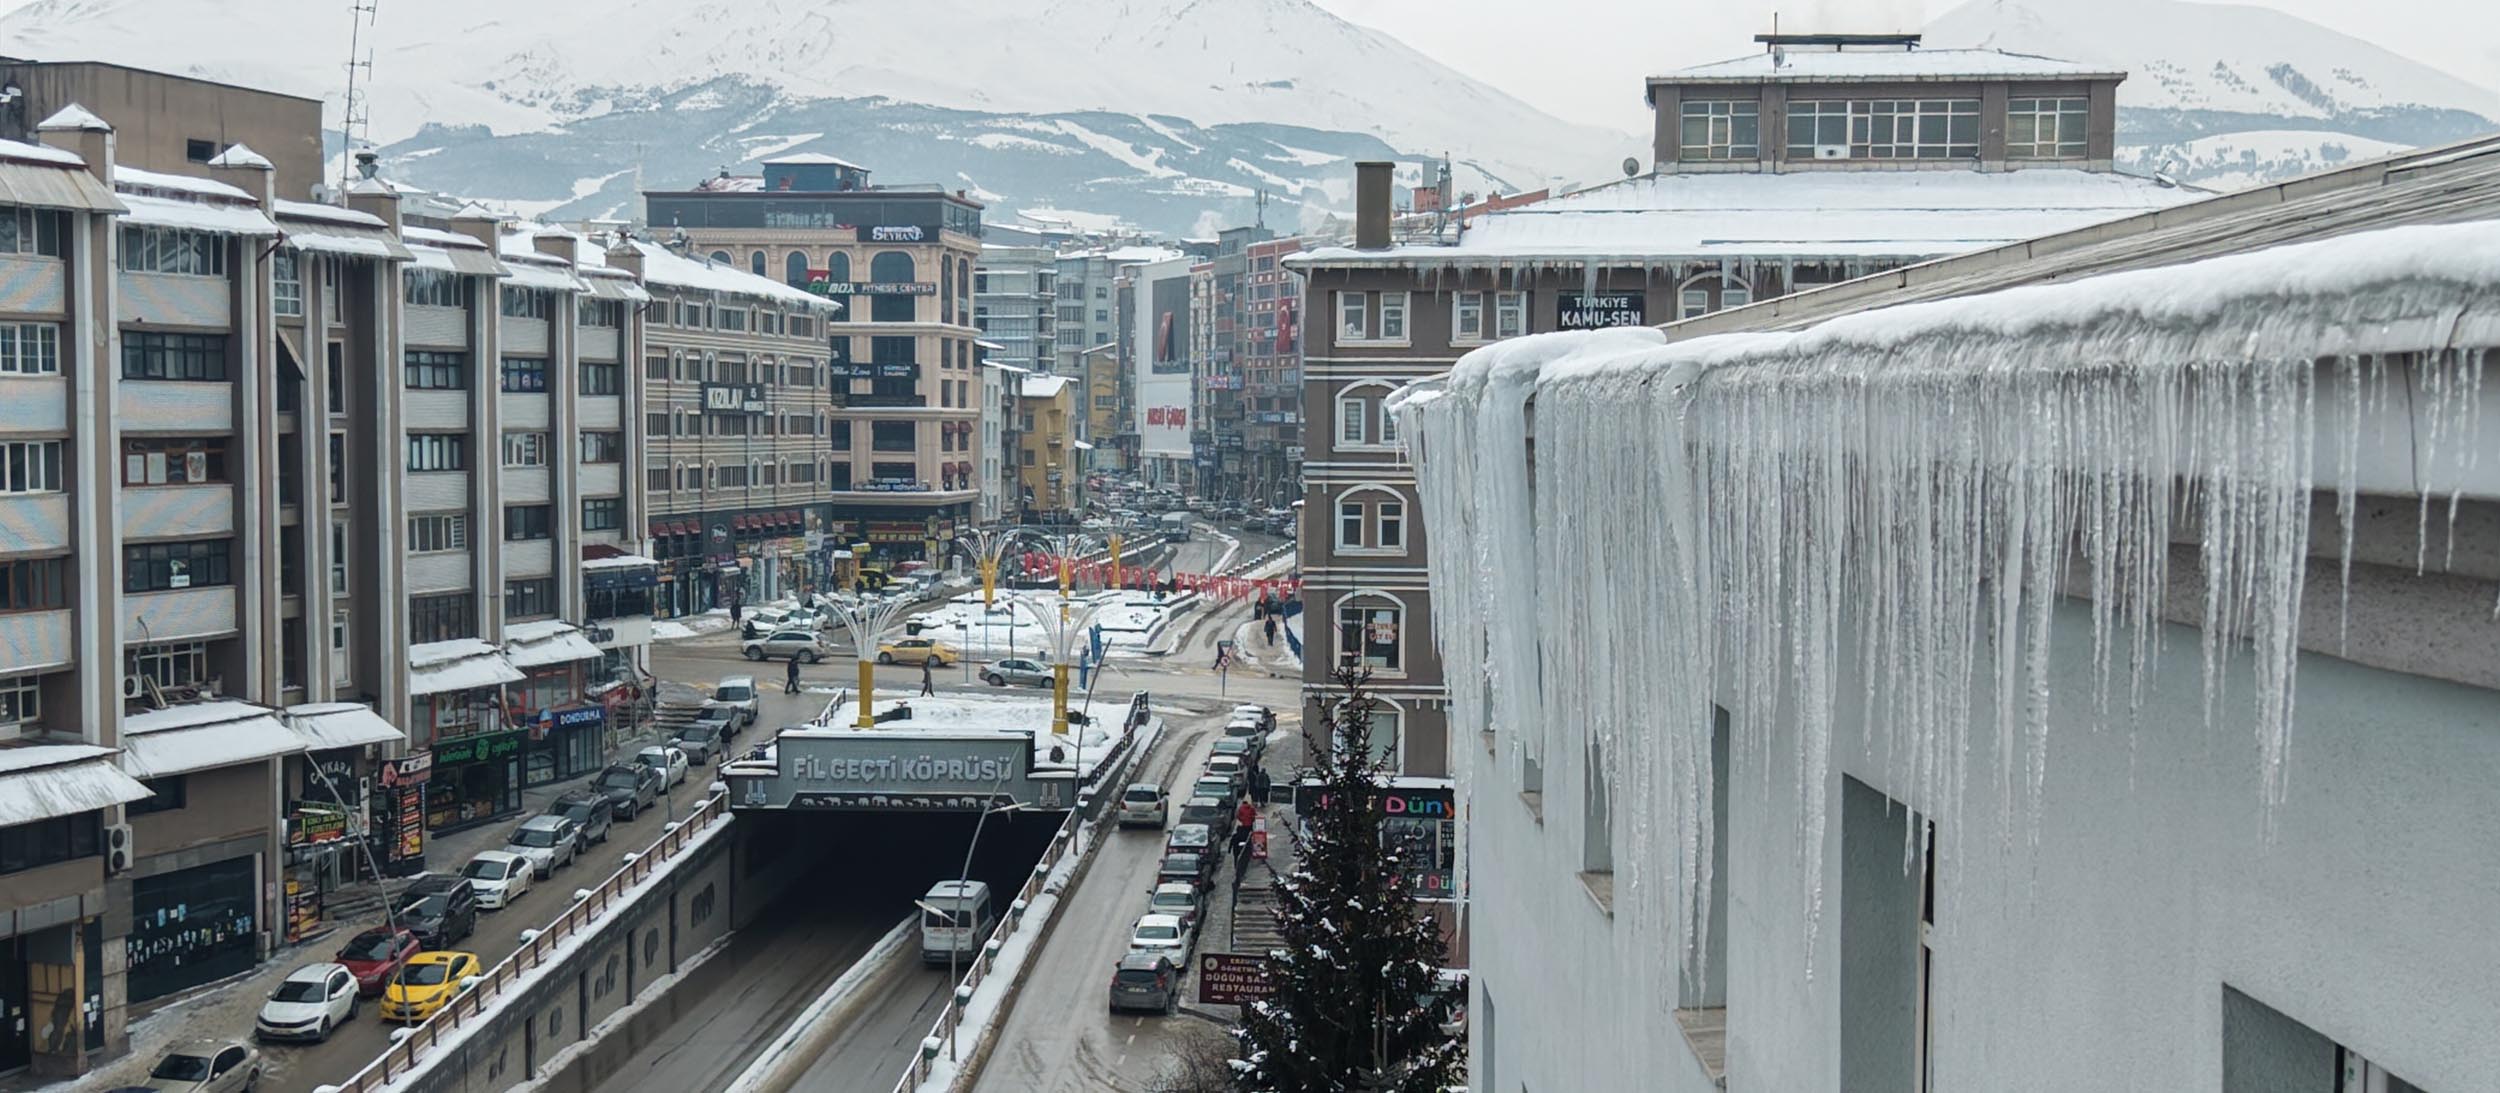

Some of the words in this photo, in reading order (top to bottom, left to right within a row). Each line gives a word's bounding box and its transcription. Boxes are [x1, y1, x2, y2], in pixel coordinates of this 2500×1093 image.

[1561, 310, 1641, 327] KAMU-SEN
[793, 754, 825, 779] FİL
[830, 755, 896, 783] GEÇTİ
[901, 755, 1013, 781] KÖPRÜSÜ
[1205, 972, 1244, 983] DÜĞÜN
